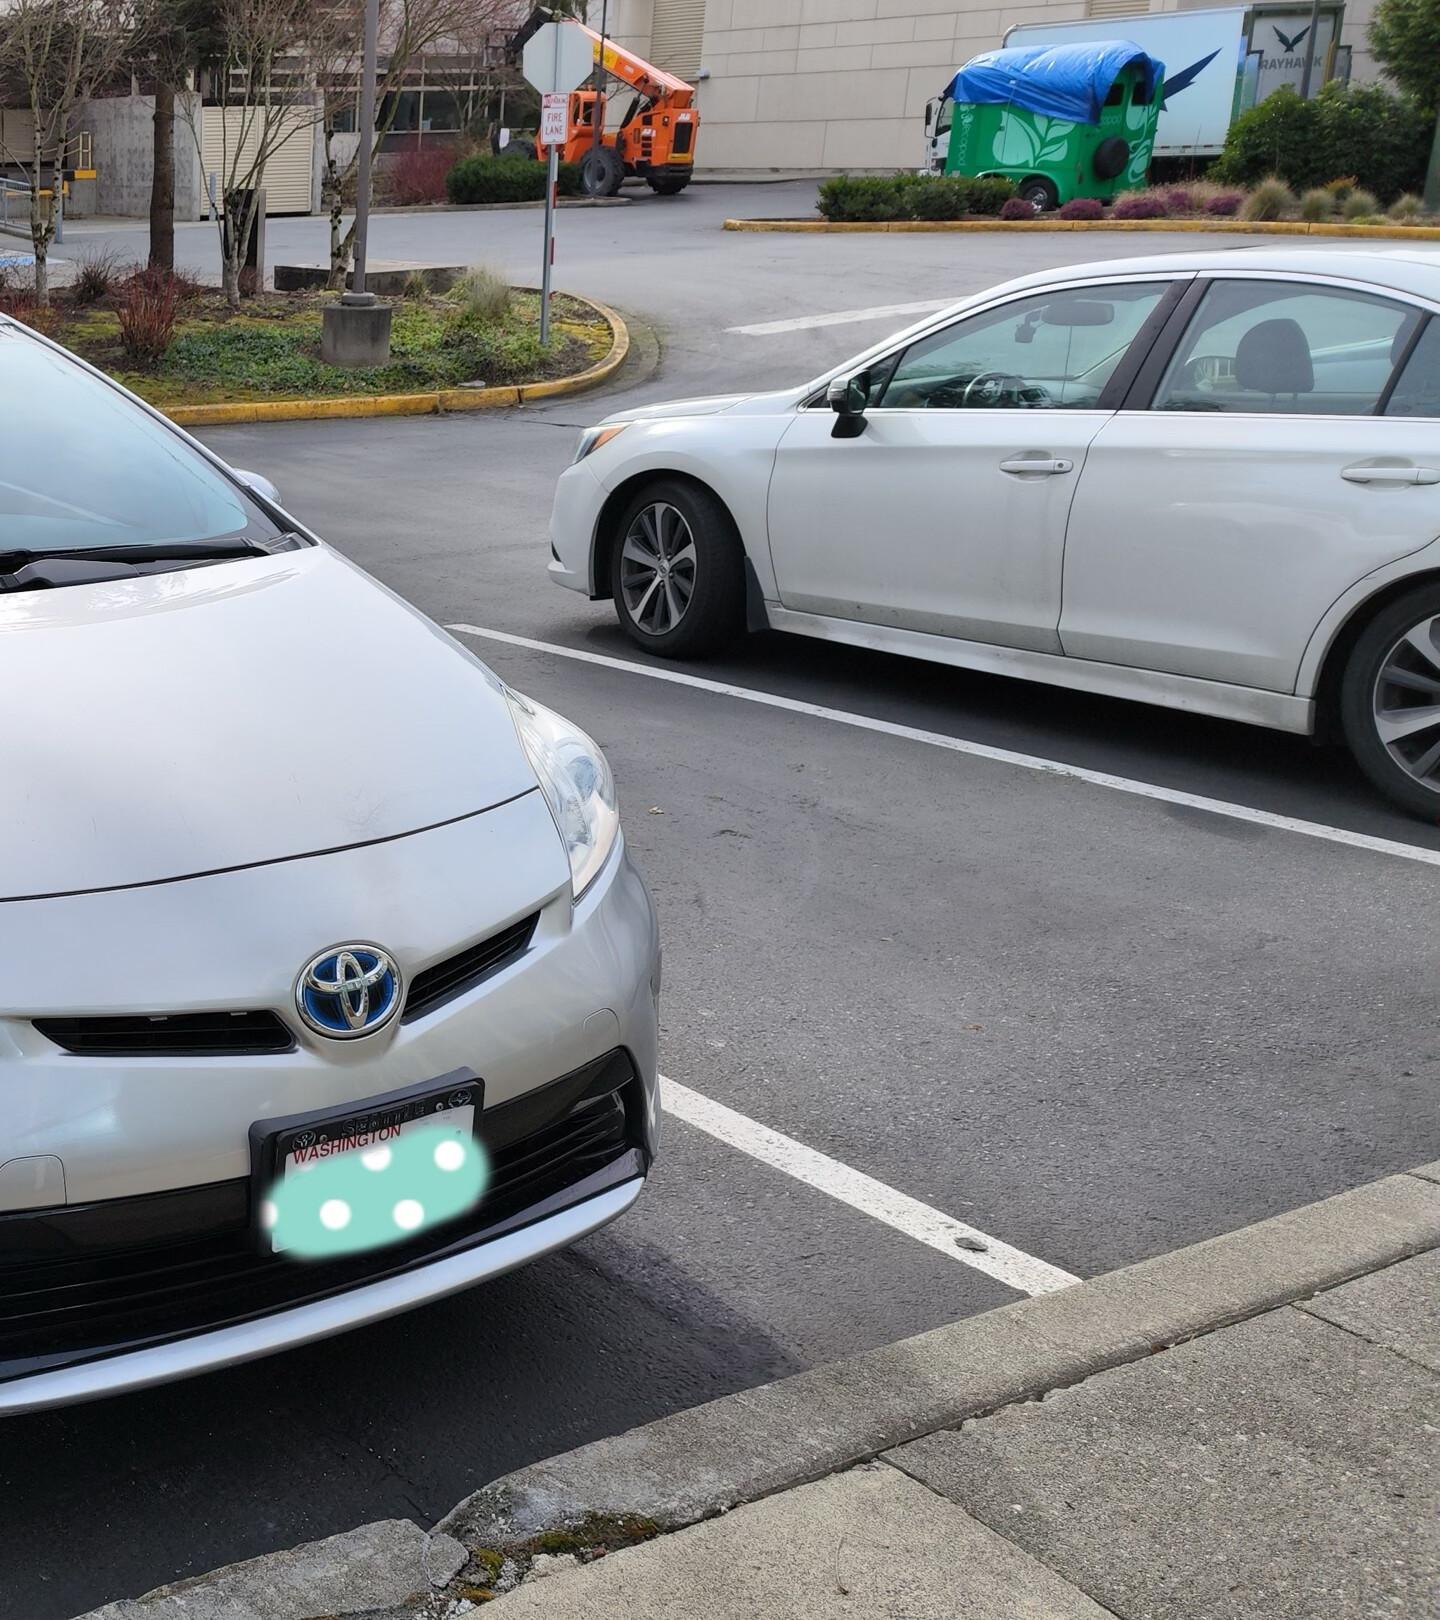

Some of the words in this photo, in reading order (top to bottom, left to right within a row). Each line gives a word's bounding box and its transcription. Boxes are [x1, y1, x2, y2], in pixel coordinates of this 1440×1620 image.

[547, 112, 563, 122] FIRE
[545, 125, 563, 136] LANE
[292, 1124, 402, 1165] WASHINGTON
